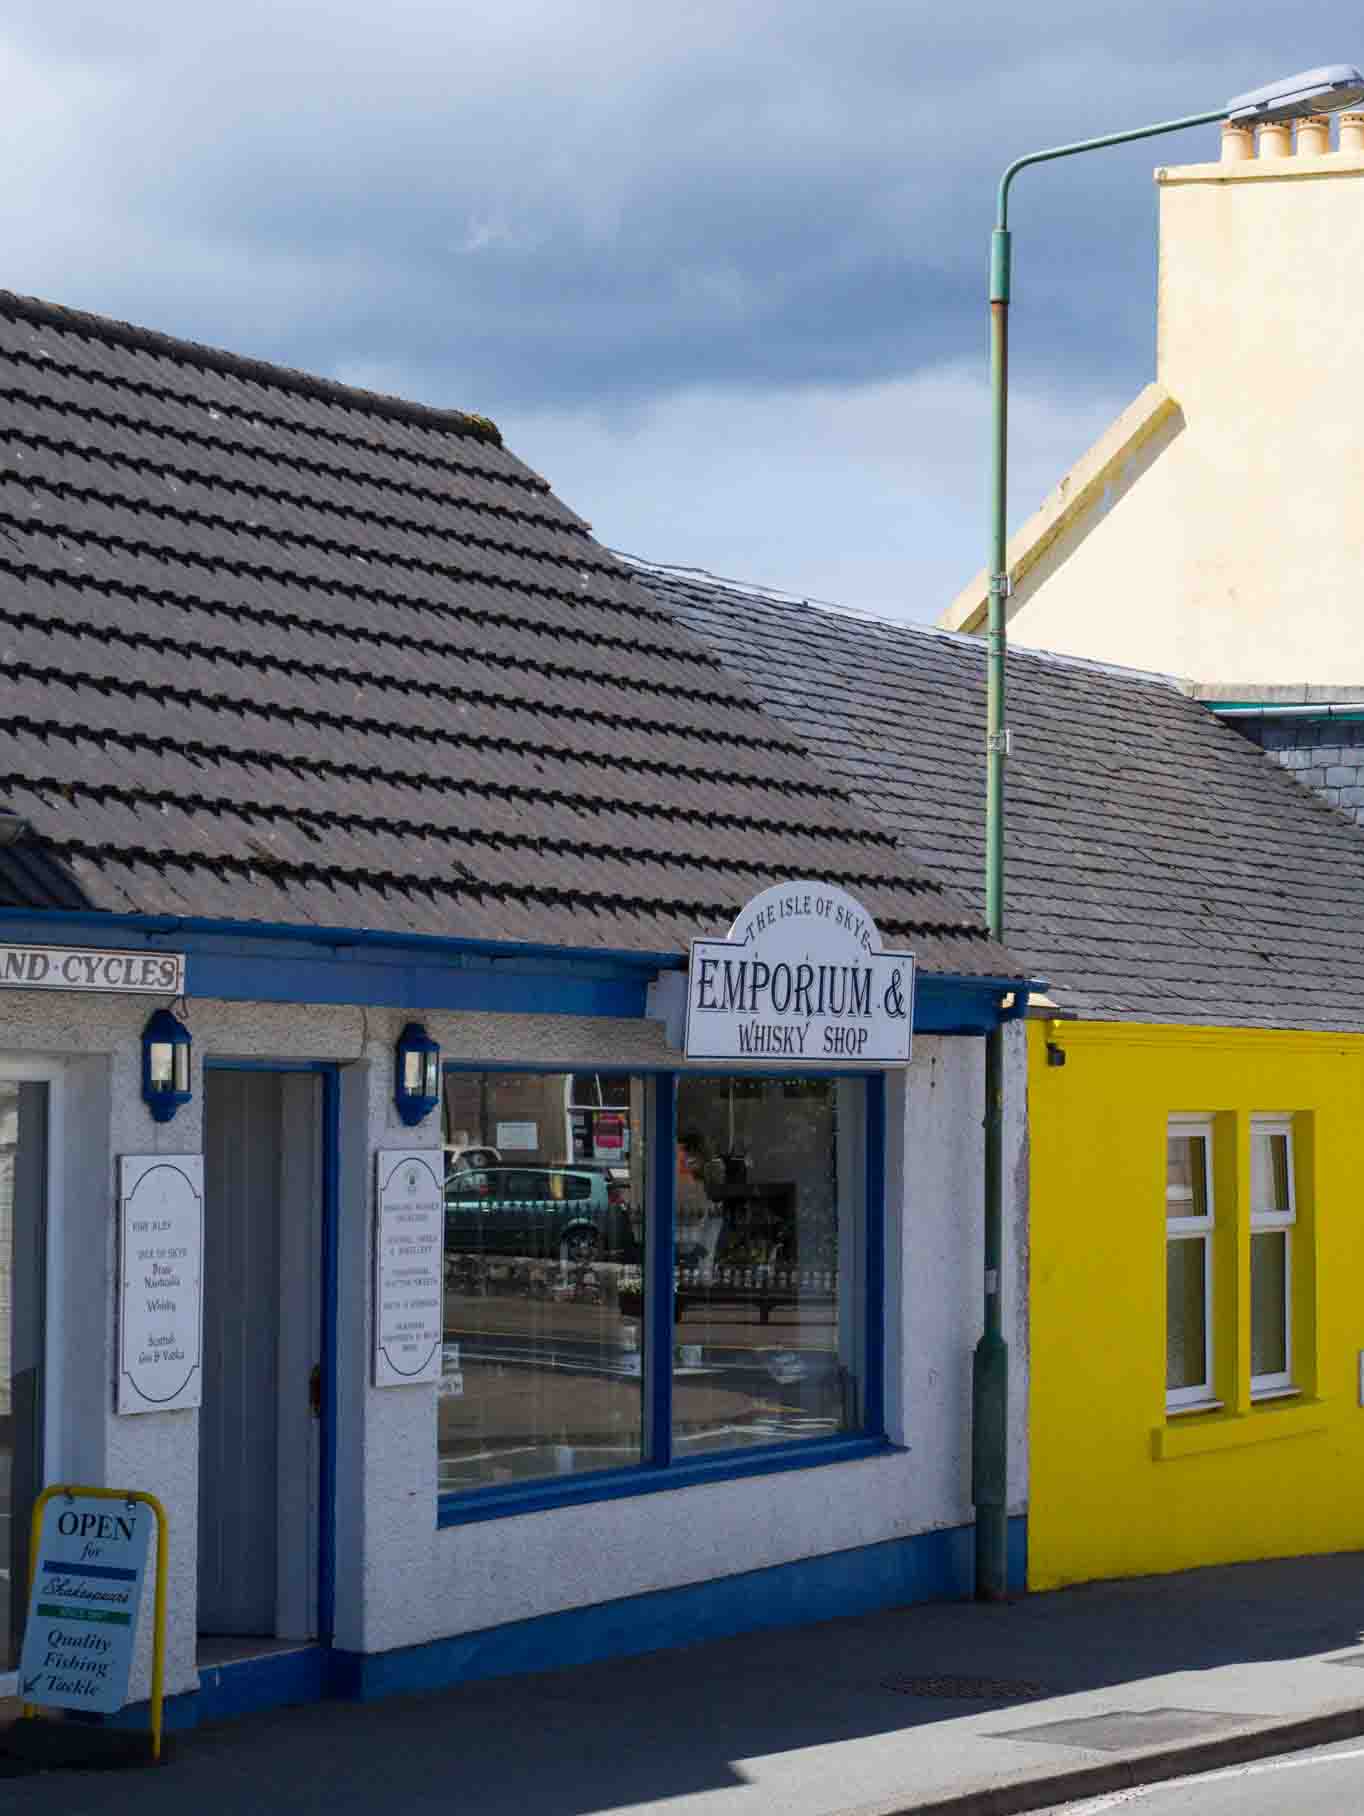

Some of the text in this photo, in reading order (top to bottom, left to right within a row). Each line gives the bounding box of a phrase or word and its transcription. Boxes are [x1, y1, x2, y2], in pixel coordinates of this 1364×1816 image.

[745, 896, 871, 951] THE ISLE OF SKYE
[0, 953, 176, 987] ND CYCLES
[697, 957, 906, 1019] EMPORIUM &
[738, 1021, 868, 1055] WHISKY SHOP
[58, 1511, 137, 1542] OPEN
[80, 1542, 103, 1560] for
[47, 1630, 112, 1653] Quality
[43, 1651, 110, 1678] Fishing
[46, 1675, 101, 1697] Tackle
